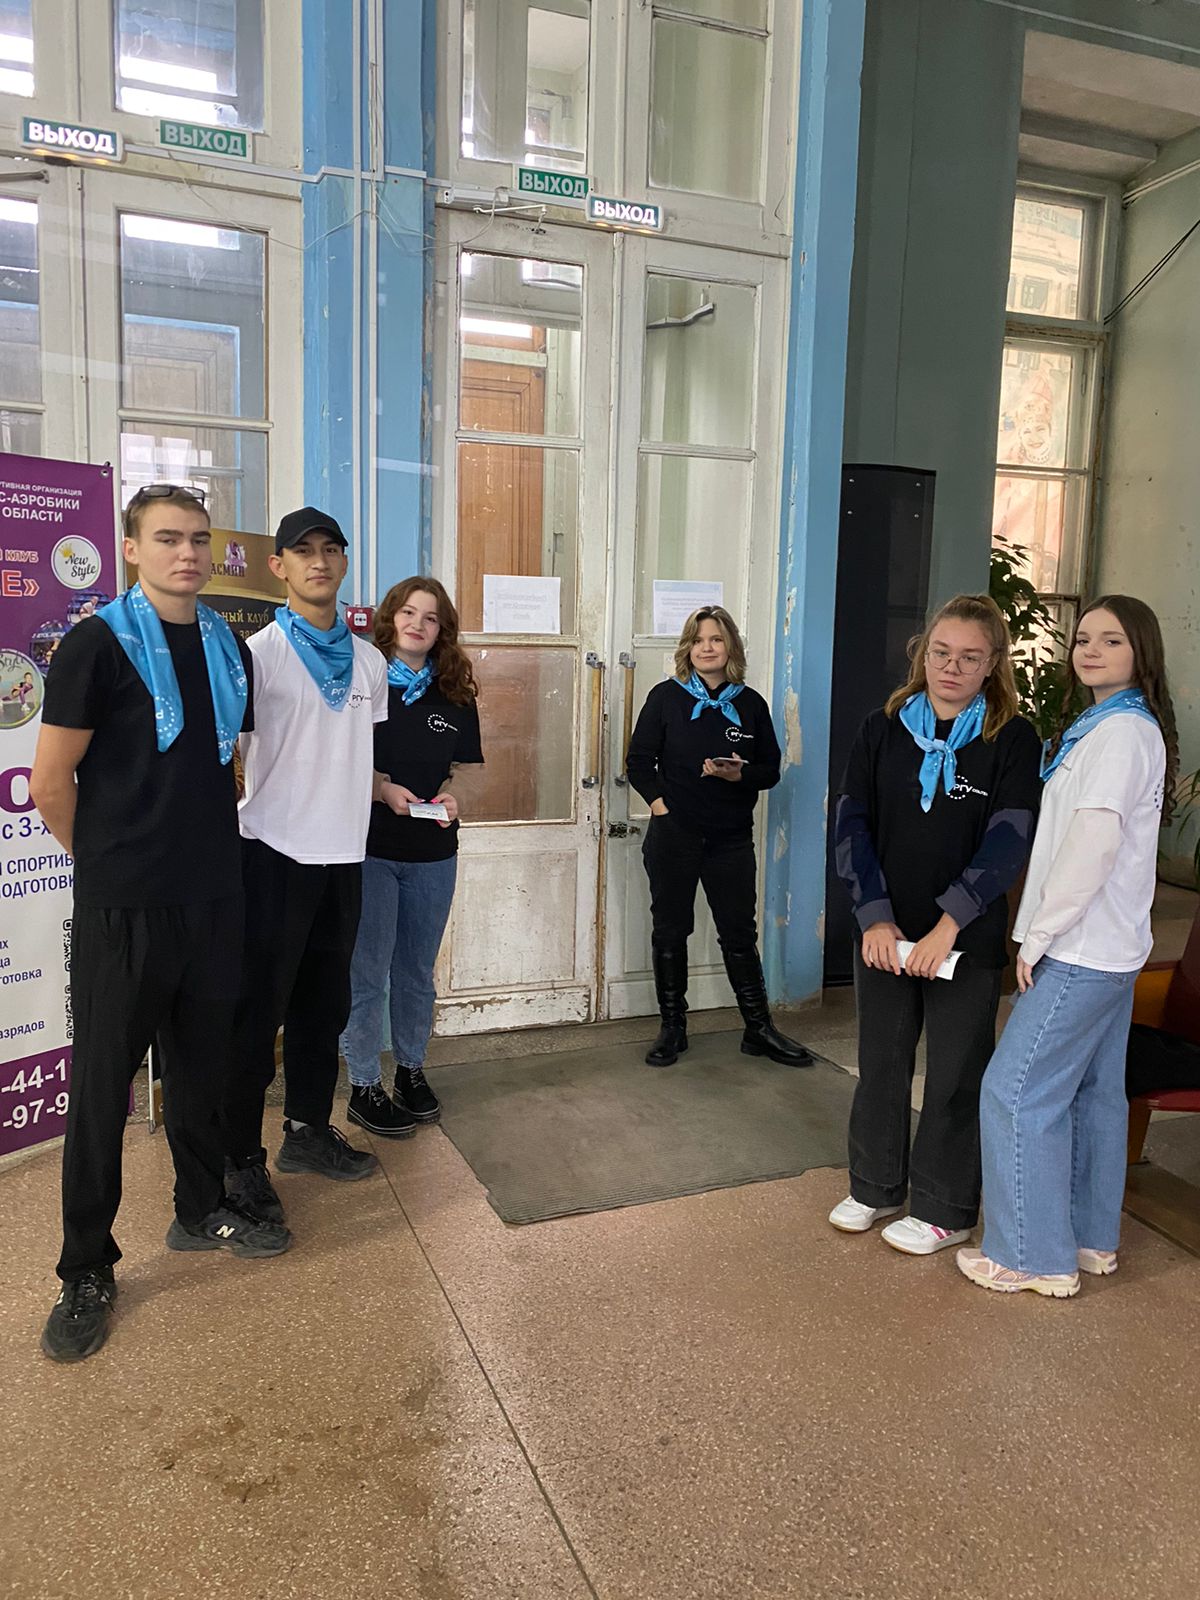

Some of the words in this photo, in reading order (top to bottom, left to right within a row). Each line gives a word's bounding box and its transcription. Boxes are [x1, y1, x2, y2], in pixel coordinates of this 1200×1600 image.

[28, 121, 115, 154] ВЫХОД
[164, 123, 244, 156] ВЫХОД
[521, 173, 586, 199] ВЫХОД
[594, 200, 656, 226] ВЫХОД
[31, 484, 83, 497] ОРГАНИЗАЦИЯ
[2, 506, 63, 523] ОБЛАСТИ
[5, 549, 39, 563] КЛУБ
[65, 553, 89, 564] New
[71, 563, 97, 581] Style
